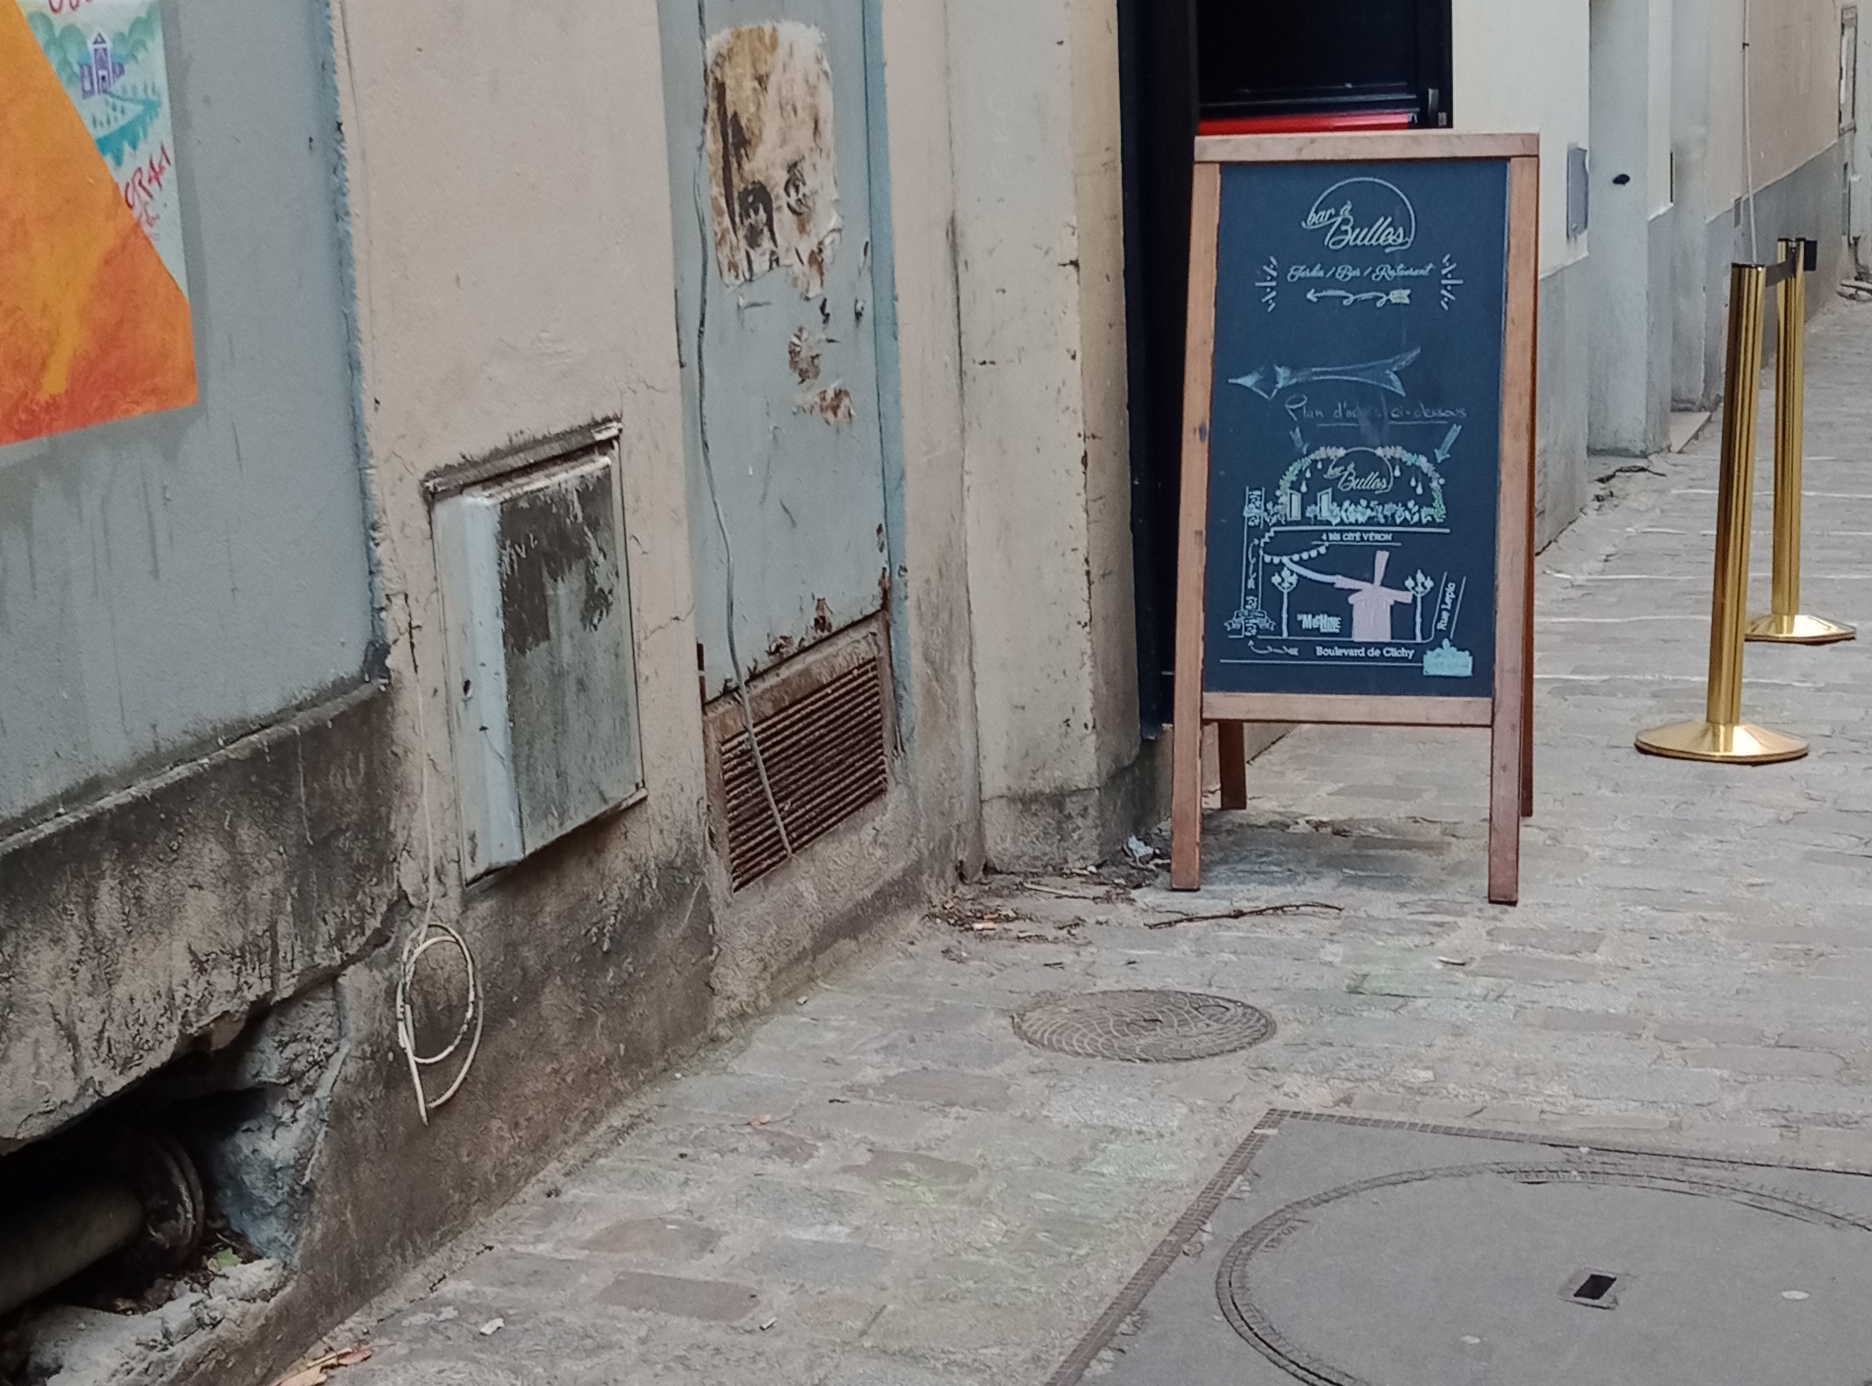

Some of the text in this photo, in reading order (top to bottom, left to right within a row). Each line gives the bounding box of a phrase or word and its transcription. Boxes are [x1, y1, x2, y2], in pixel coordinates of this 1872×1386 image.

[1303, 200, 1353, 229] bar à
[1324, 216, 1409, 251] Bulles
[1335, 265, 1361, 281] Bar
[1285, 394, 1324, 421] Plan
[1315, 646, 1415, 660] Boulevard de Clichy
